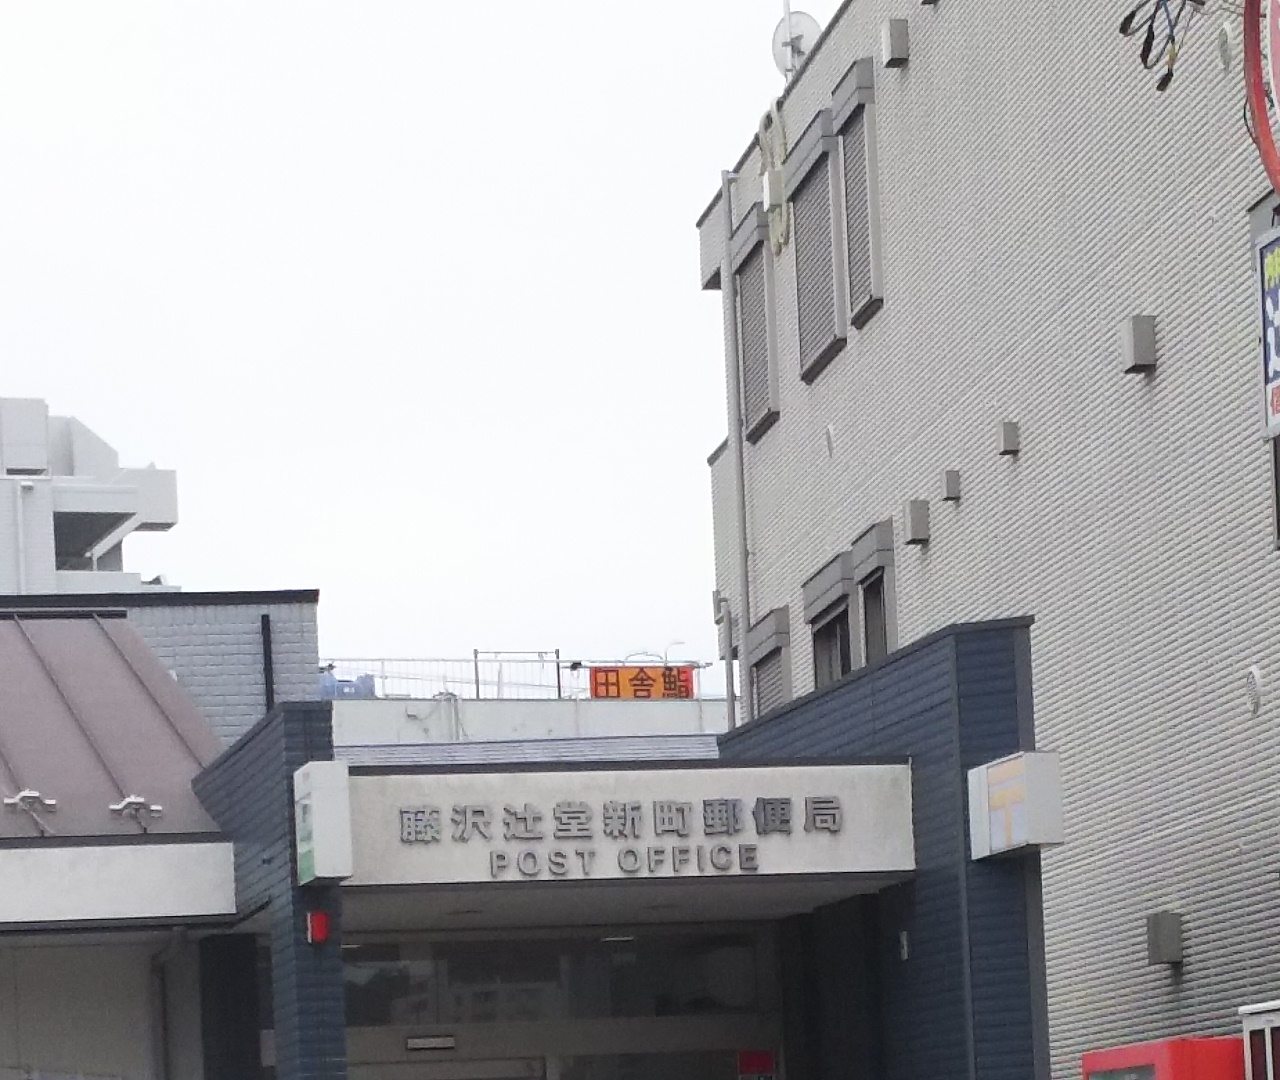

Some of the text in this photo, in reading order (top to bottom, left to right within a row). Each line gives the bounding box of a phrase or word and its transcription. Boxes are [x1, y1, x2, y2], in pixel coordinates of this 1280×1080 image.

[399, 795, 845, 845] 藤沢辻堂新町郵便局
[489, 842, 760, 878] POST OFFICE
